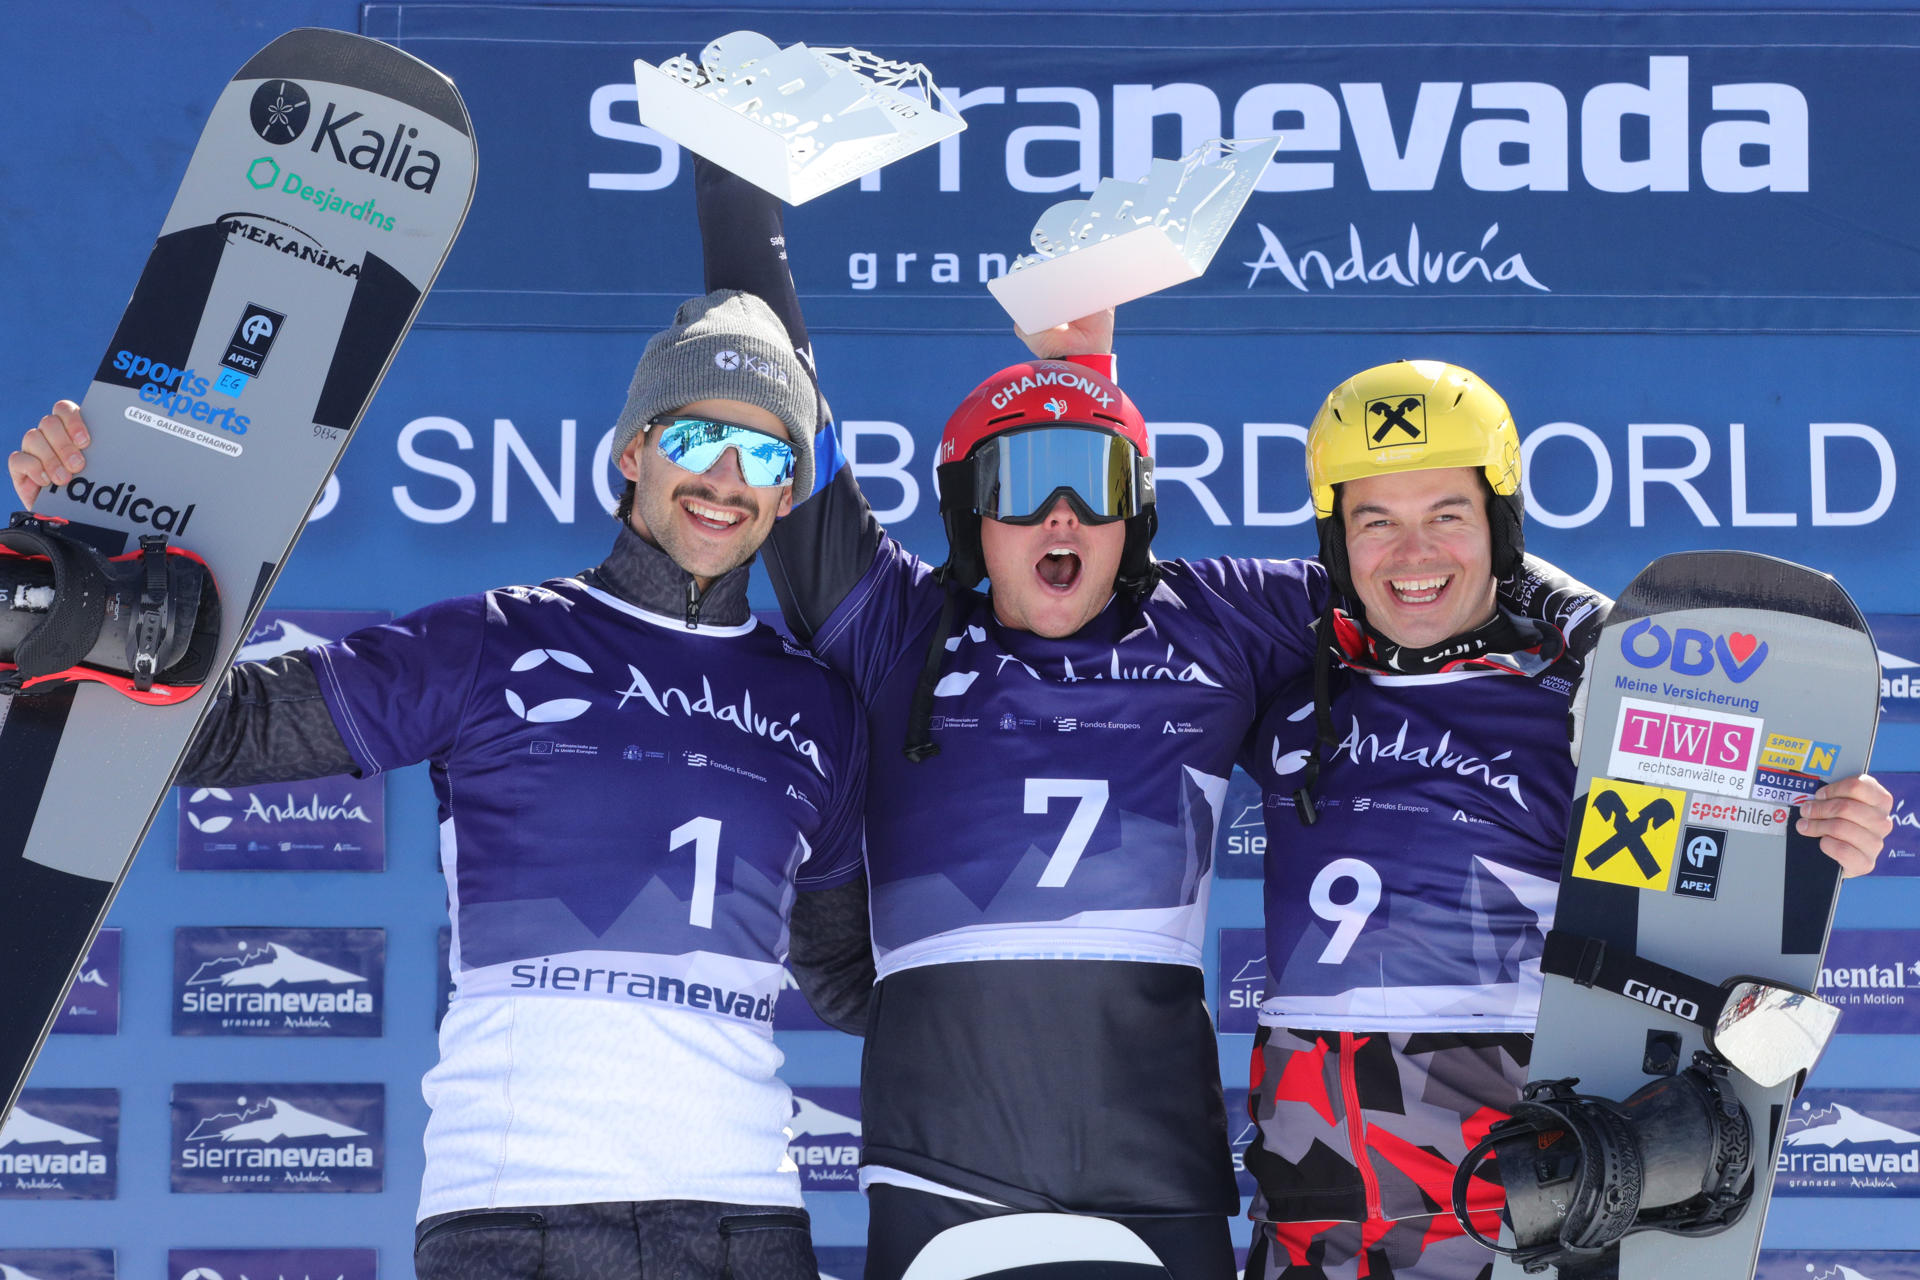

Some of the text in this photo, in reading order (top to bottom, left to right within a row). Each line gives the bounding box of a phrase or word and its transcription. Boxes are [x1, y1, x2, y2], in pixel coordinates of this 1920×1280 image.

[589, 55, 1810, 194] sranevada
[310, 102, 441, 194] Kalia
[282, 170, 397, 235] Desjardins
[849, 221, 1551, 292] gran Andalucía
[113, 350, 210, 398] sports
[228, 352, 258, 370] APEX
[744, 354, 788, 383] Kalia
[220, 374, 241, 390] EG
[991, 372, 1115, 410] CHAMONIX
[139, 382, 251, 436] experts
[128, 408, 239, 454] LÉVIS GALERIES CHAGNON
[1521, 420, 1898, 529] ORLD
[1620, 617, 1769, 684] ÖBV
[1615, 675, 1760, 713] Meine Versicherung
[615, 663, 827, 778] Andalucía
[1108, 721, 1141, 730] Europeos
[1630, 715, 1742, 764] TWS
[1771, 737, 1806, 750] SPORT
[710, 759, 768, 783] Fondos Europeos
[1329, 714, 1530, 813] Andalucía
[1637, 758, 1745, 790] rechtsanwälte og
[1768, 754, 1796, 767] LAND
[1757, 787, 1793, 802] SPORT
[1759, 773, 1807, 790] POLIZEI
[243, 792, 372, 824] Andalucía
[1372, 802, 1430, 814] Fondos Europeos
[1691, 800, 1772, 827] sporthilfe
[1023, 778, 1110, 888] 7
[669, 816, 722, 929] 1
[1680, 879, 1712, 893] APEX
[1308, 857, 1382, 965] 9
[182, 986, 374, 1013] sierranevada
[1622, 978, 1700, 1022] GIRO
[1849, 993, 1860, 1005] in
[1863, 993, 1905, 1005] Motion
[222, 1018, 271, 1028] granada
[181, 1142, 374, 1168] sierranevada
[1775, 1149, 1920, 1173] erranevad
[222, 1174, 271, 1184] granada
[1789, 1178, 1837, 1188] granada
